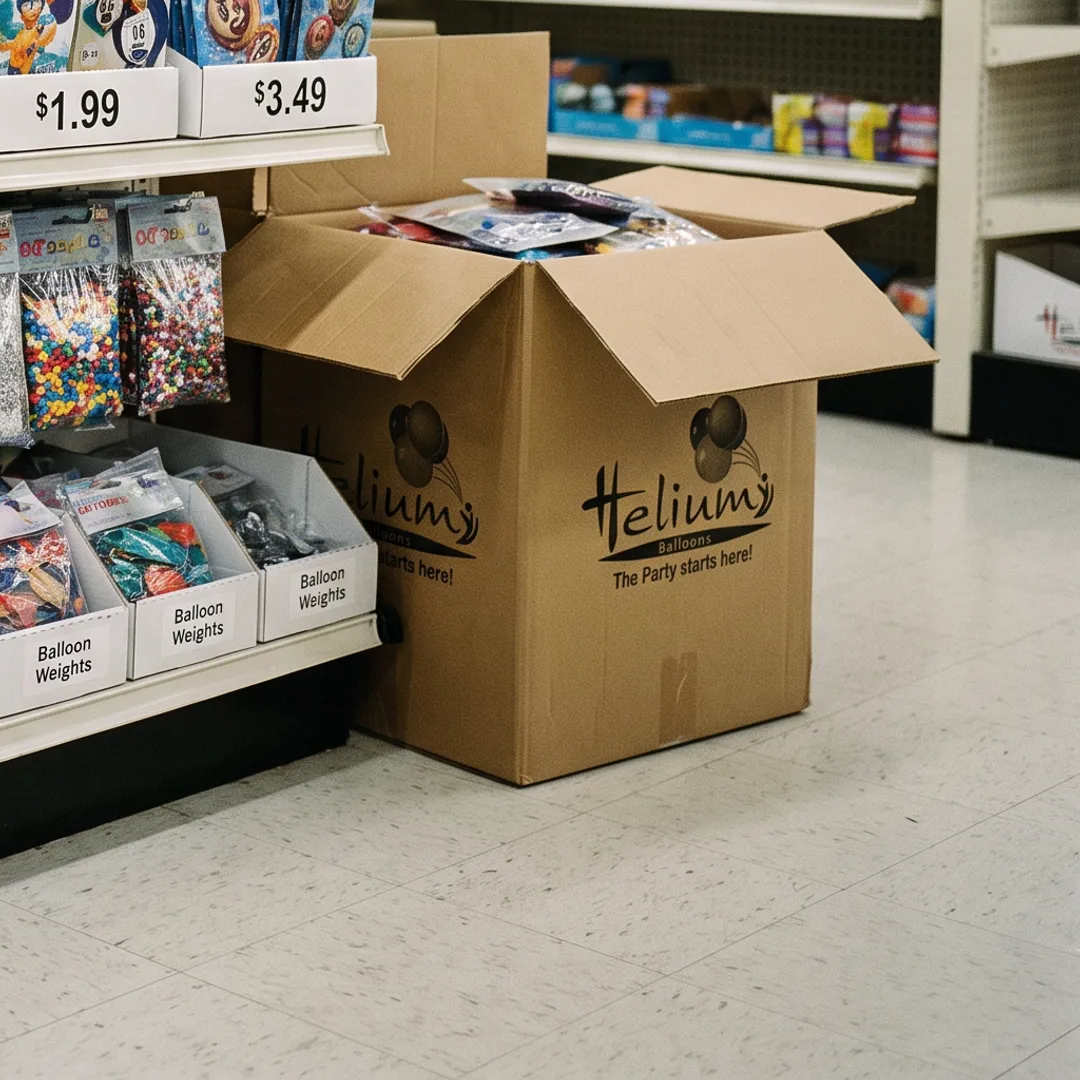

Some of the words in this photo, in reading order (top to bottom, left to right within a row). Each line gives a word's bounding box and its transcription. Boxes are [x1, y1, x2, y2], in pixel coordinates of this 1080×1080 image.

[254, 76, 327, 116] $3.49
[35, 88, 120, 130] $1.99
[581, 460, 760, 554] Helium
[658, 534, 712, 554] Balloons
[300, 568, 345, 589] Balloon
[419, 559, 454, 585] here!
[613, 572, 638, 589] The
[642, 563, 677, 584] Party
[680, 554, 717, 575] starts
[720, 544, 753, 567] here!
[299, 586, 346, 610] Weights
[174, 602, 223, 625] Balloon
[172, 622, 224, 645] Weights
[38, 638, 91, 662] Balloon
[35, 659, 92, 684] Weights
